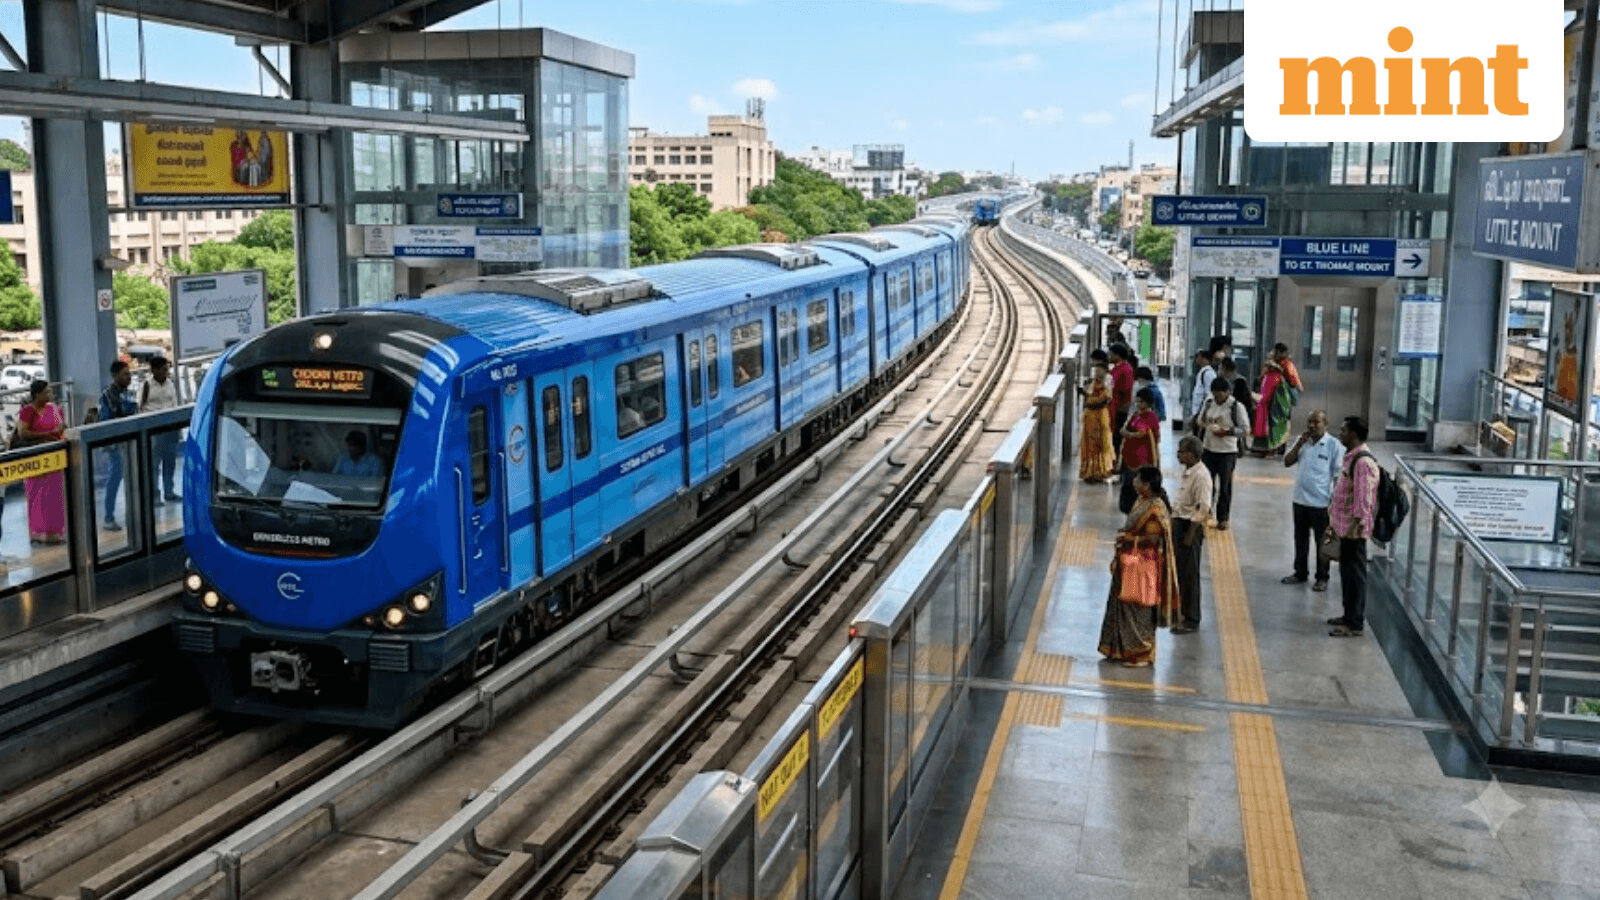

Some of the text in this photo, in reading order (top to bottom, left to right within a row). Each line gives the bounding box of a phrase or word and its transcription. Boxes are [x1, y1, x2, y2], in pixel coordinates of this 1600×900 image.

[1485, 218, 1563, 252] LITTLE MOUNT
[1306, 242, 1370, 254] BLUE LINE
[1284, 260, 1298, 270] TO
[1356, 262, 1391, 272] MOUNT
